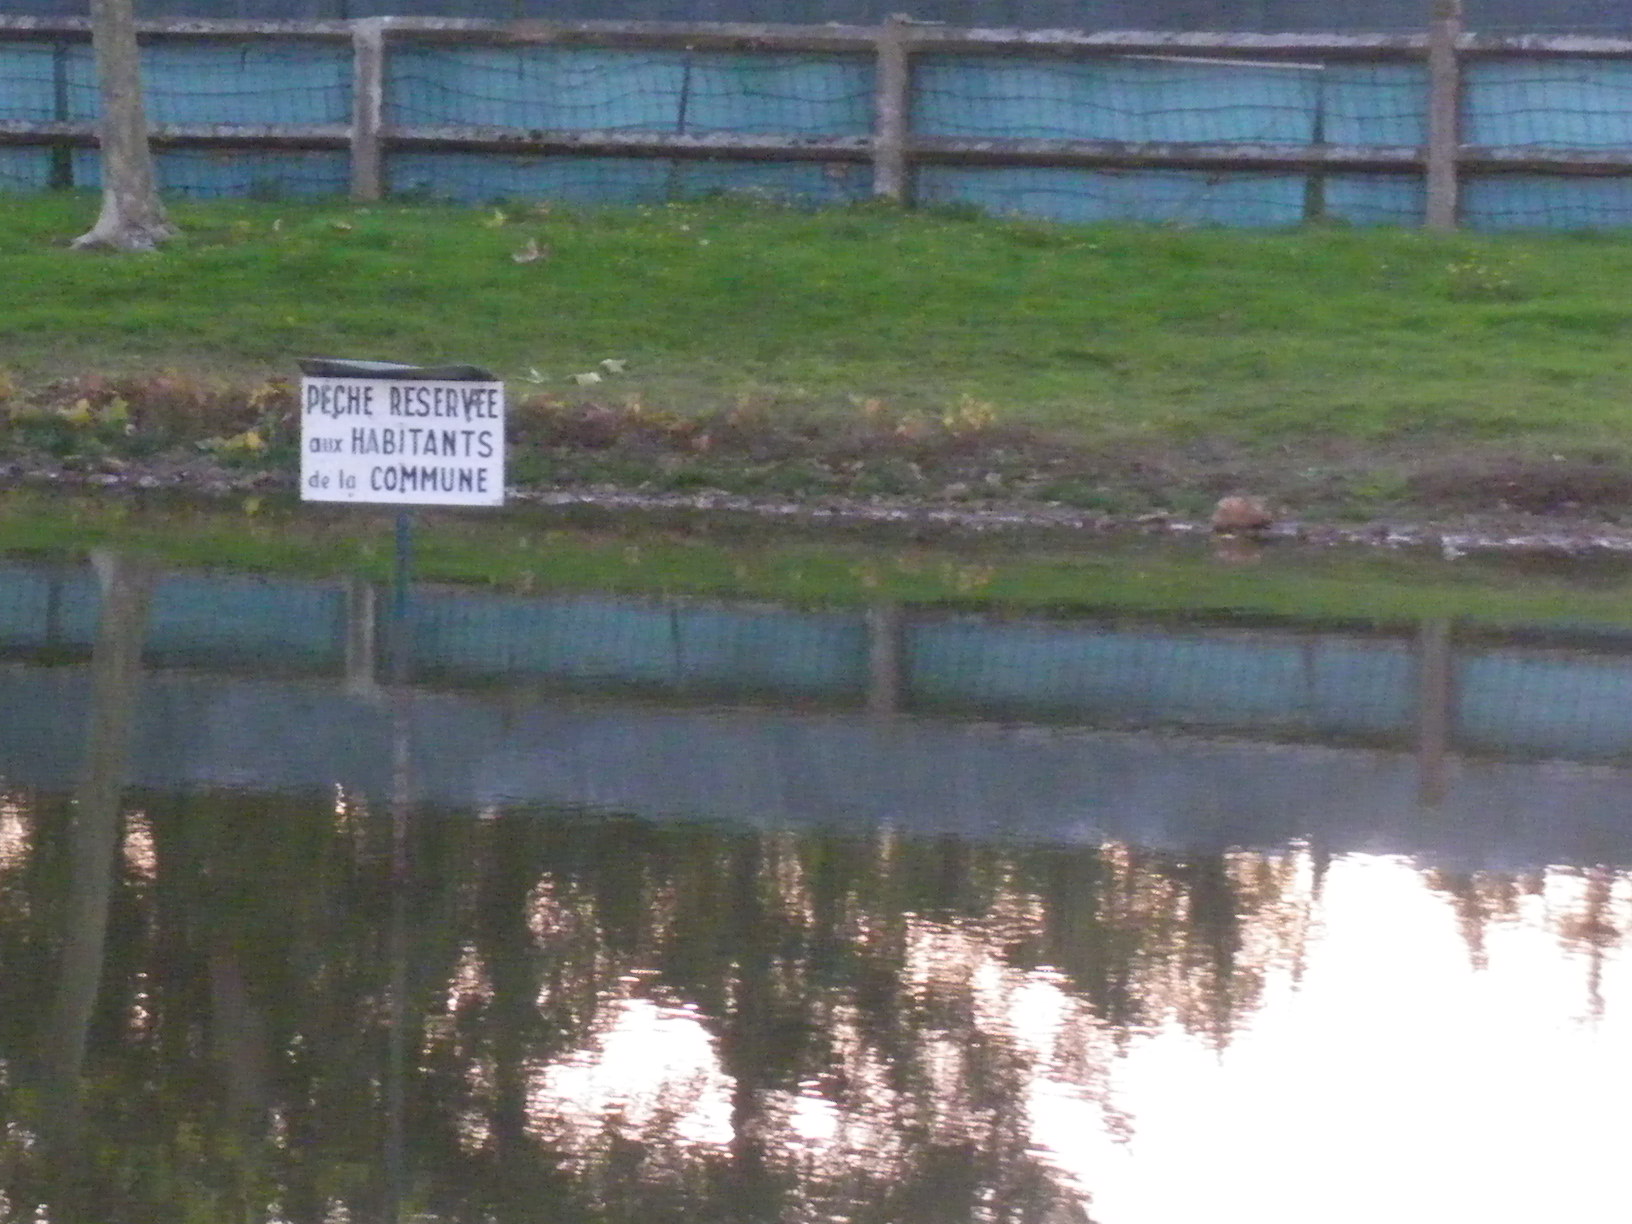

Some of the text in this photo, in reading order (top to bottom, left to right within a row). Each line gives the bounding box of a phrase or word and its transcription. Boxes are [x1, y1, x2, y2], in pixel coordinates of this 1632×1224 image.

[390, 386, 499, 420] RESERVEE
[309, 427, 494, 458] aux HABITANTS
[308, 466, 488, 494] de la COMMUNE
